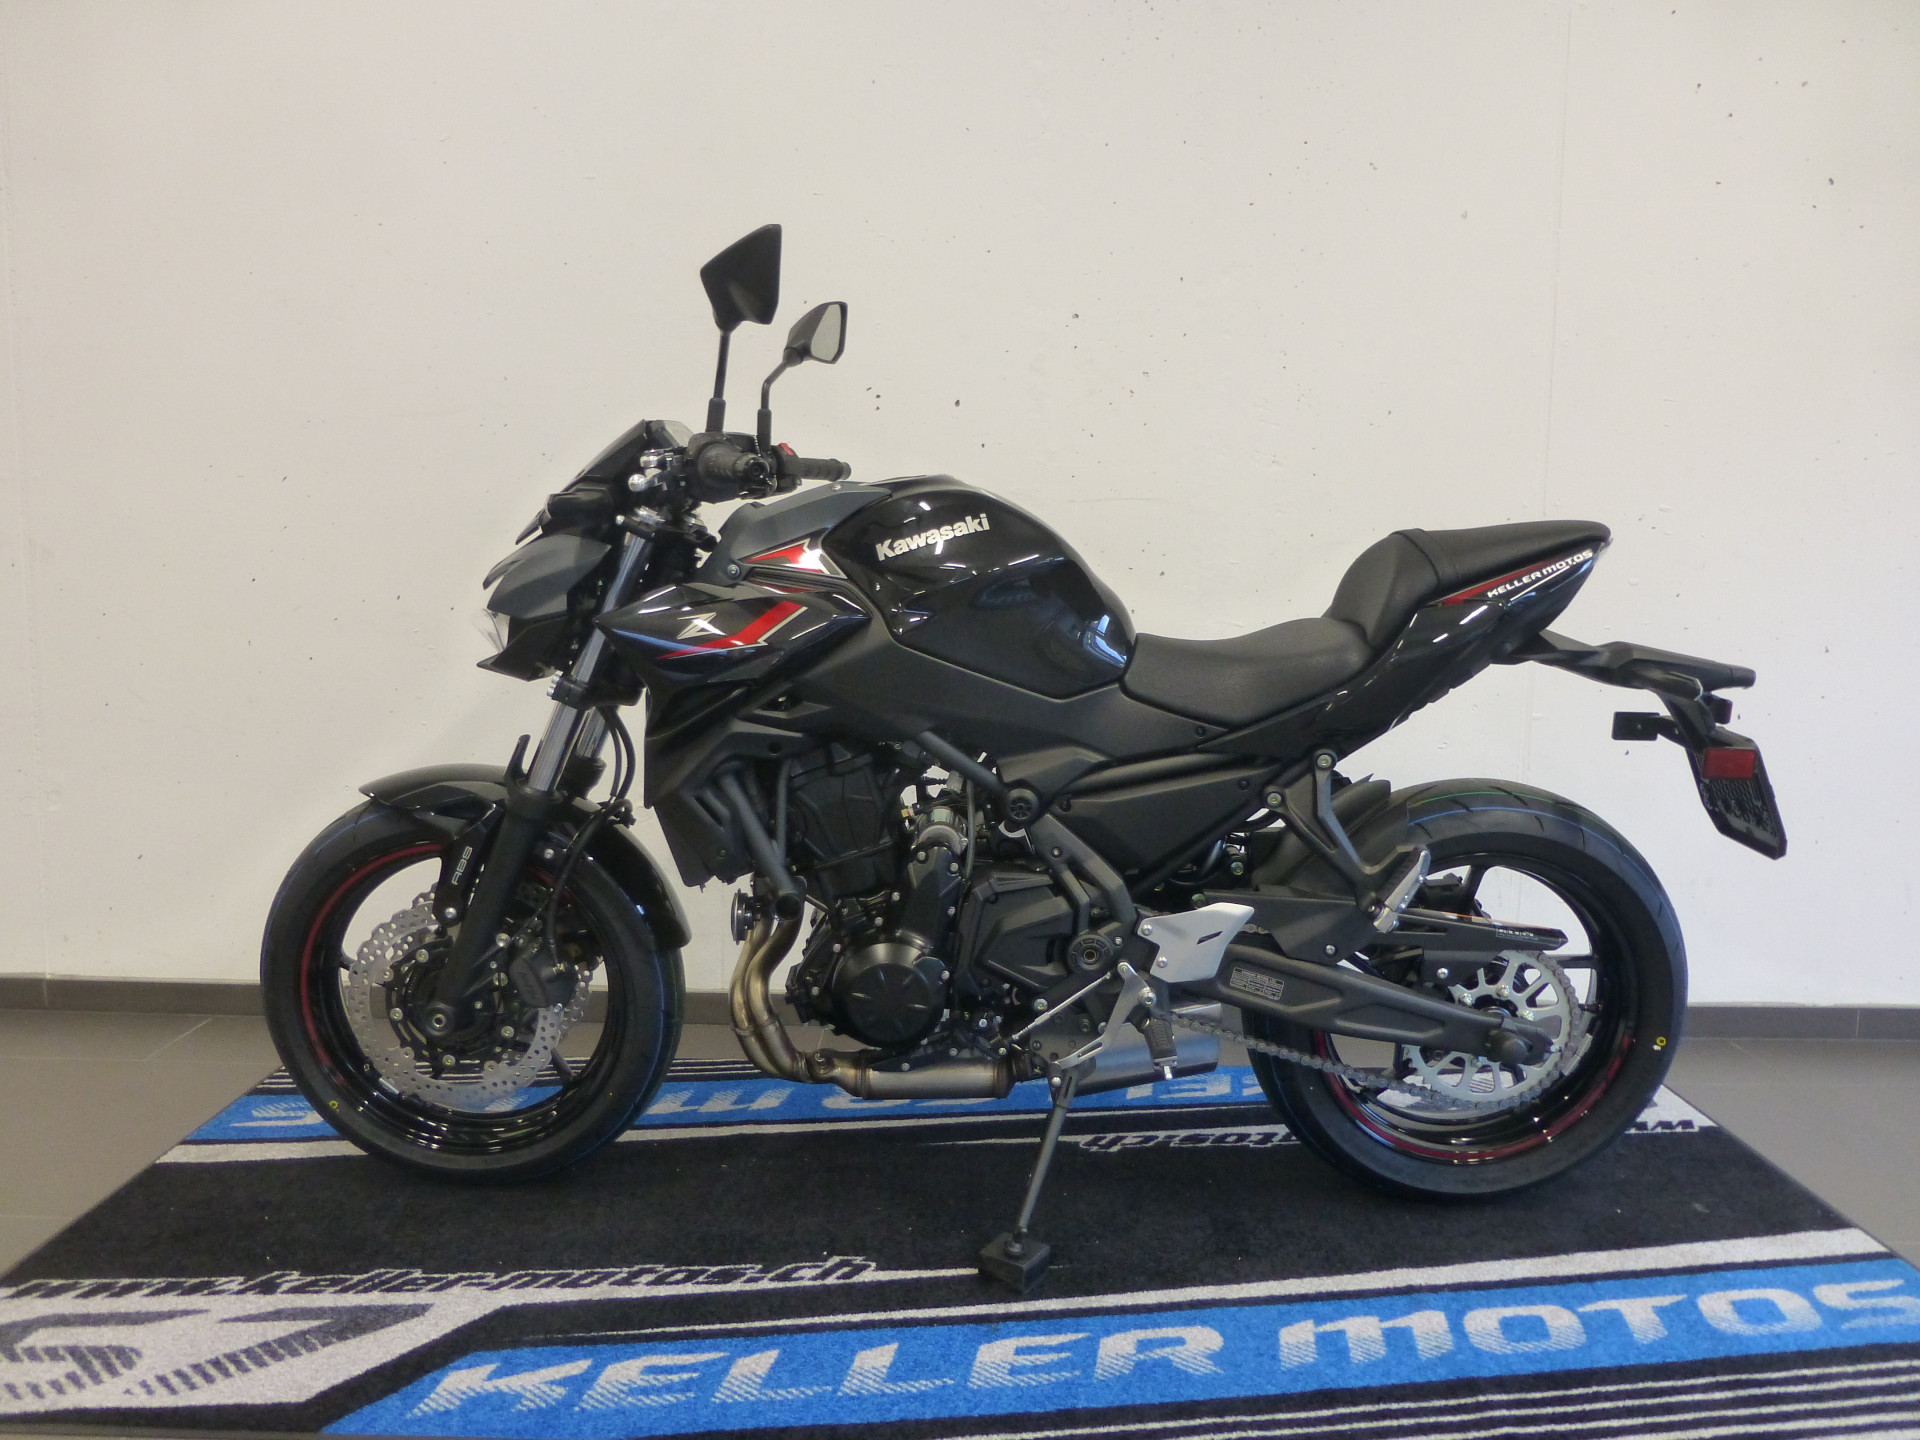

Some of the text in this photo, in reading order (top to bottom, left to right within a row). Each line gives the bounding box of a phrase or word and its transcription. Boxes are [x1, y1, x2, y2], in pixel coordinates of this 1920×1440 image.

[875, 513, 991, 561] Kawasaki
[1487, 548, 1594, 598] KELLER MOTOS
[451, 846, 473, 885] ABS
[406, 1278, 1920, 1419] KELLER MOTOS
